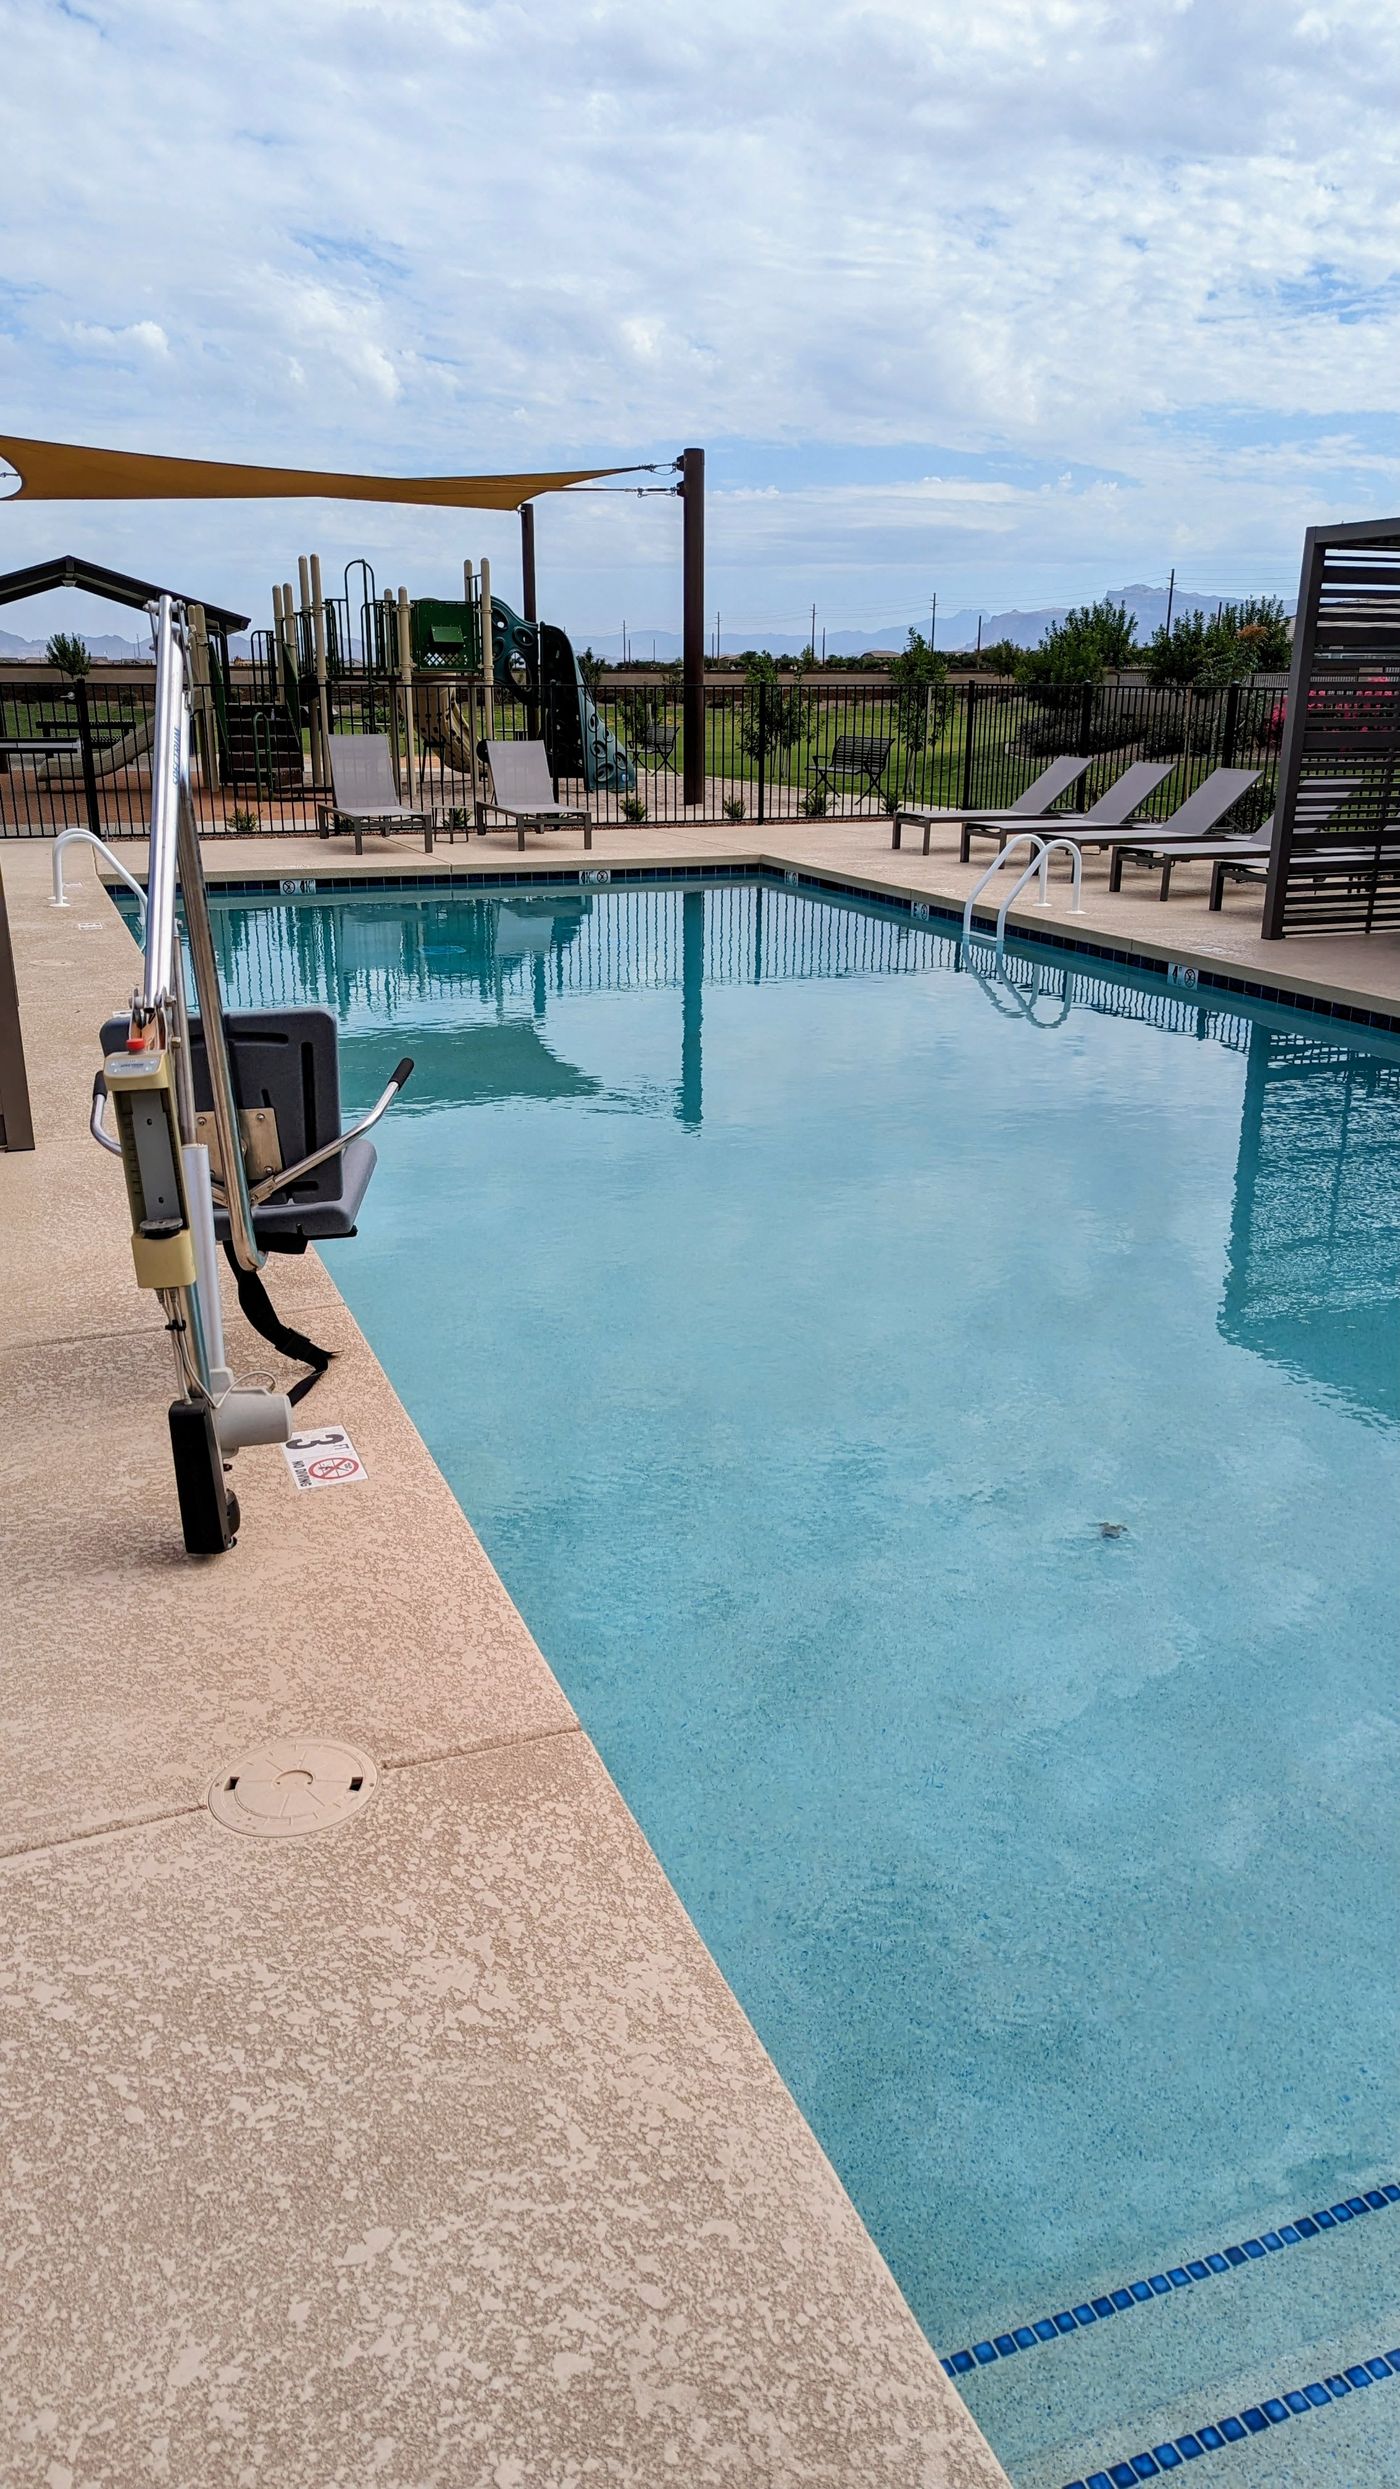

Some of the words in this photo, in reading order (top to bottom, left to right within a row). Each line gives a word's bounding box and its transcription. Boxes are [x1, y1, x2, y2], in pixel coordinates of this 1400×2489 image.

[173, 727, 182, 785] SPECTRUM
[285, 1433, 345, 1450] 3
[292, 1460, 305, 1468] NO
[295, 1468, 312, 1487] DIVING
